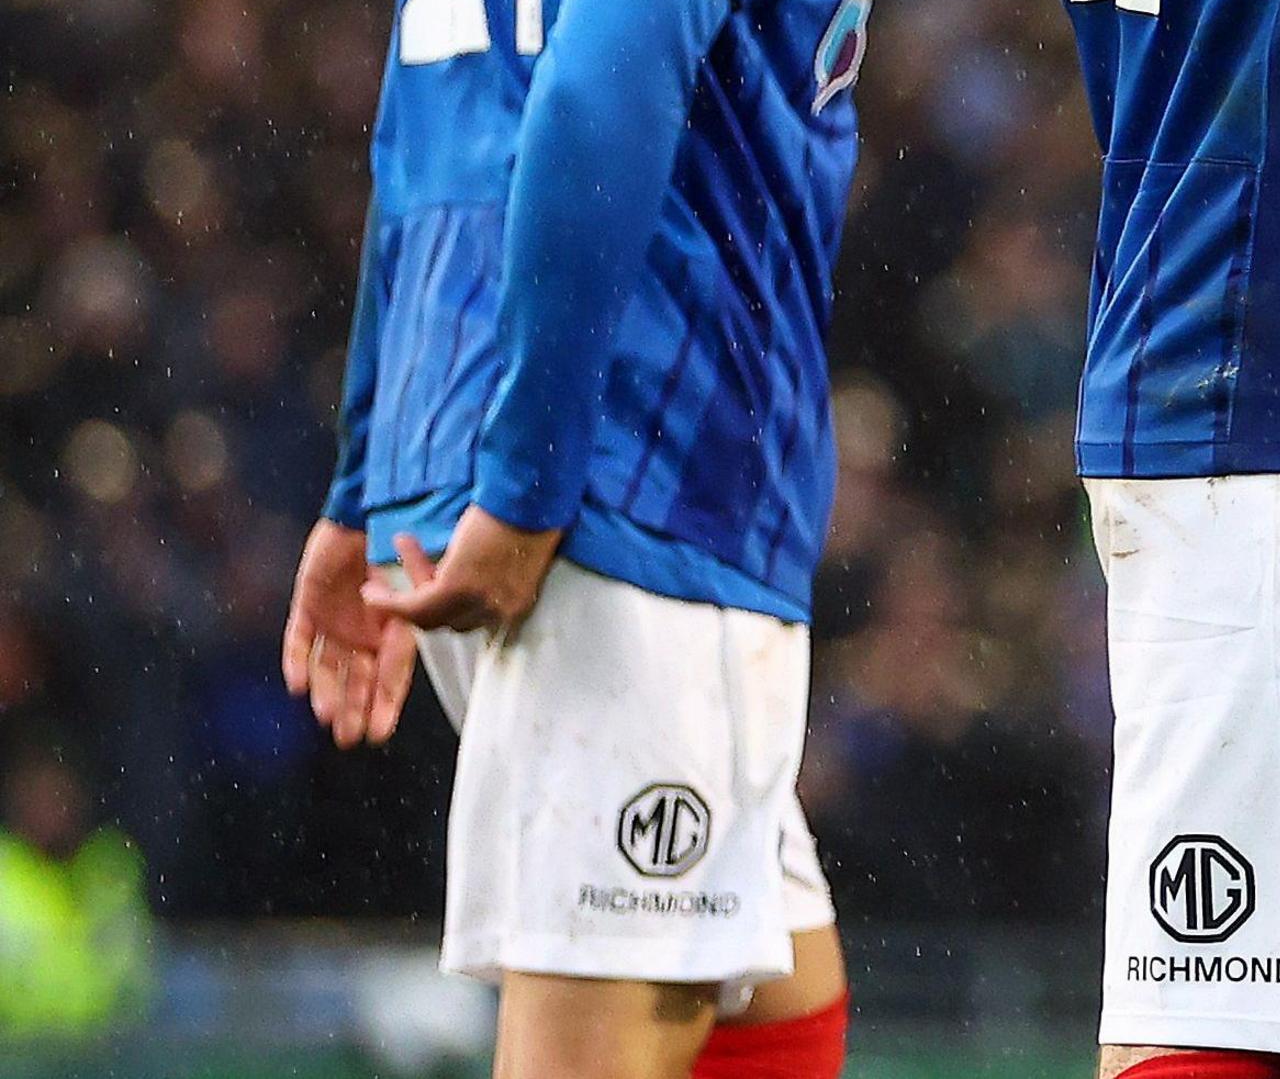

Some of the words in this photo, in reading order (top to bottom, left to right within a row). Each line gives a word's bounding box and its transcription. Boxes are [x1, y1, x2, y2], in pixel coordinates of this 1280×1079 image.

[629, 796, 701, 865] MG
[578, 884, 741, 918] RICHMOND
[1159, 847, 1242, 931] MG
